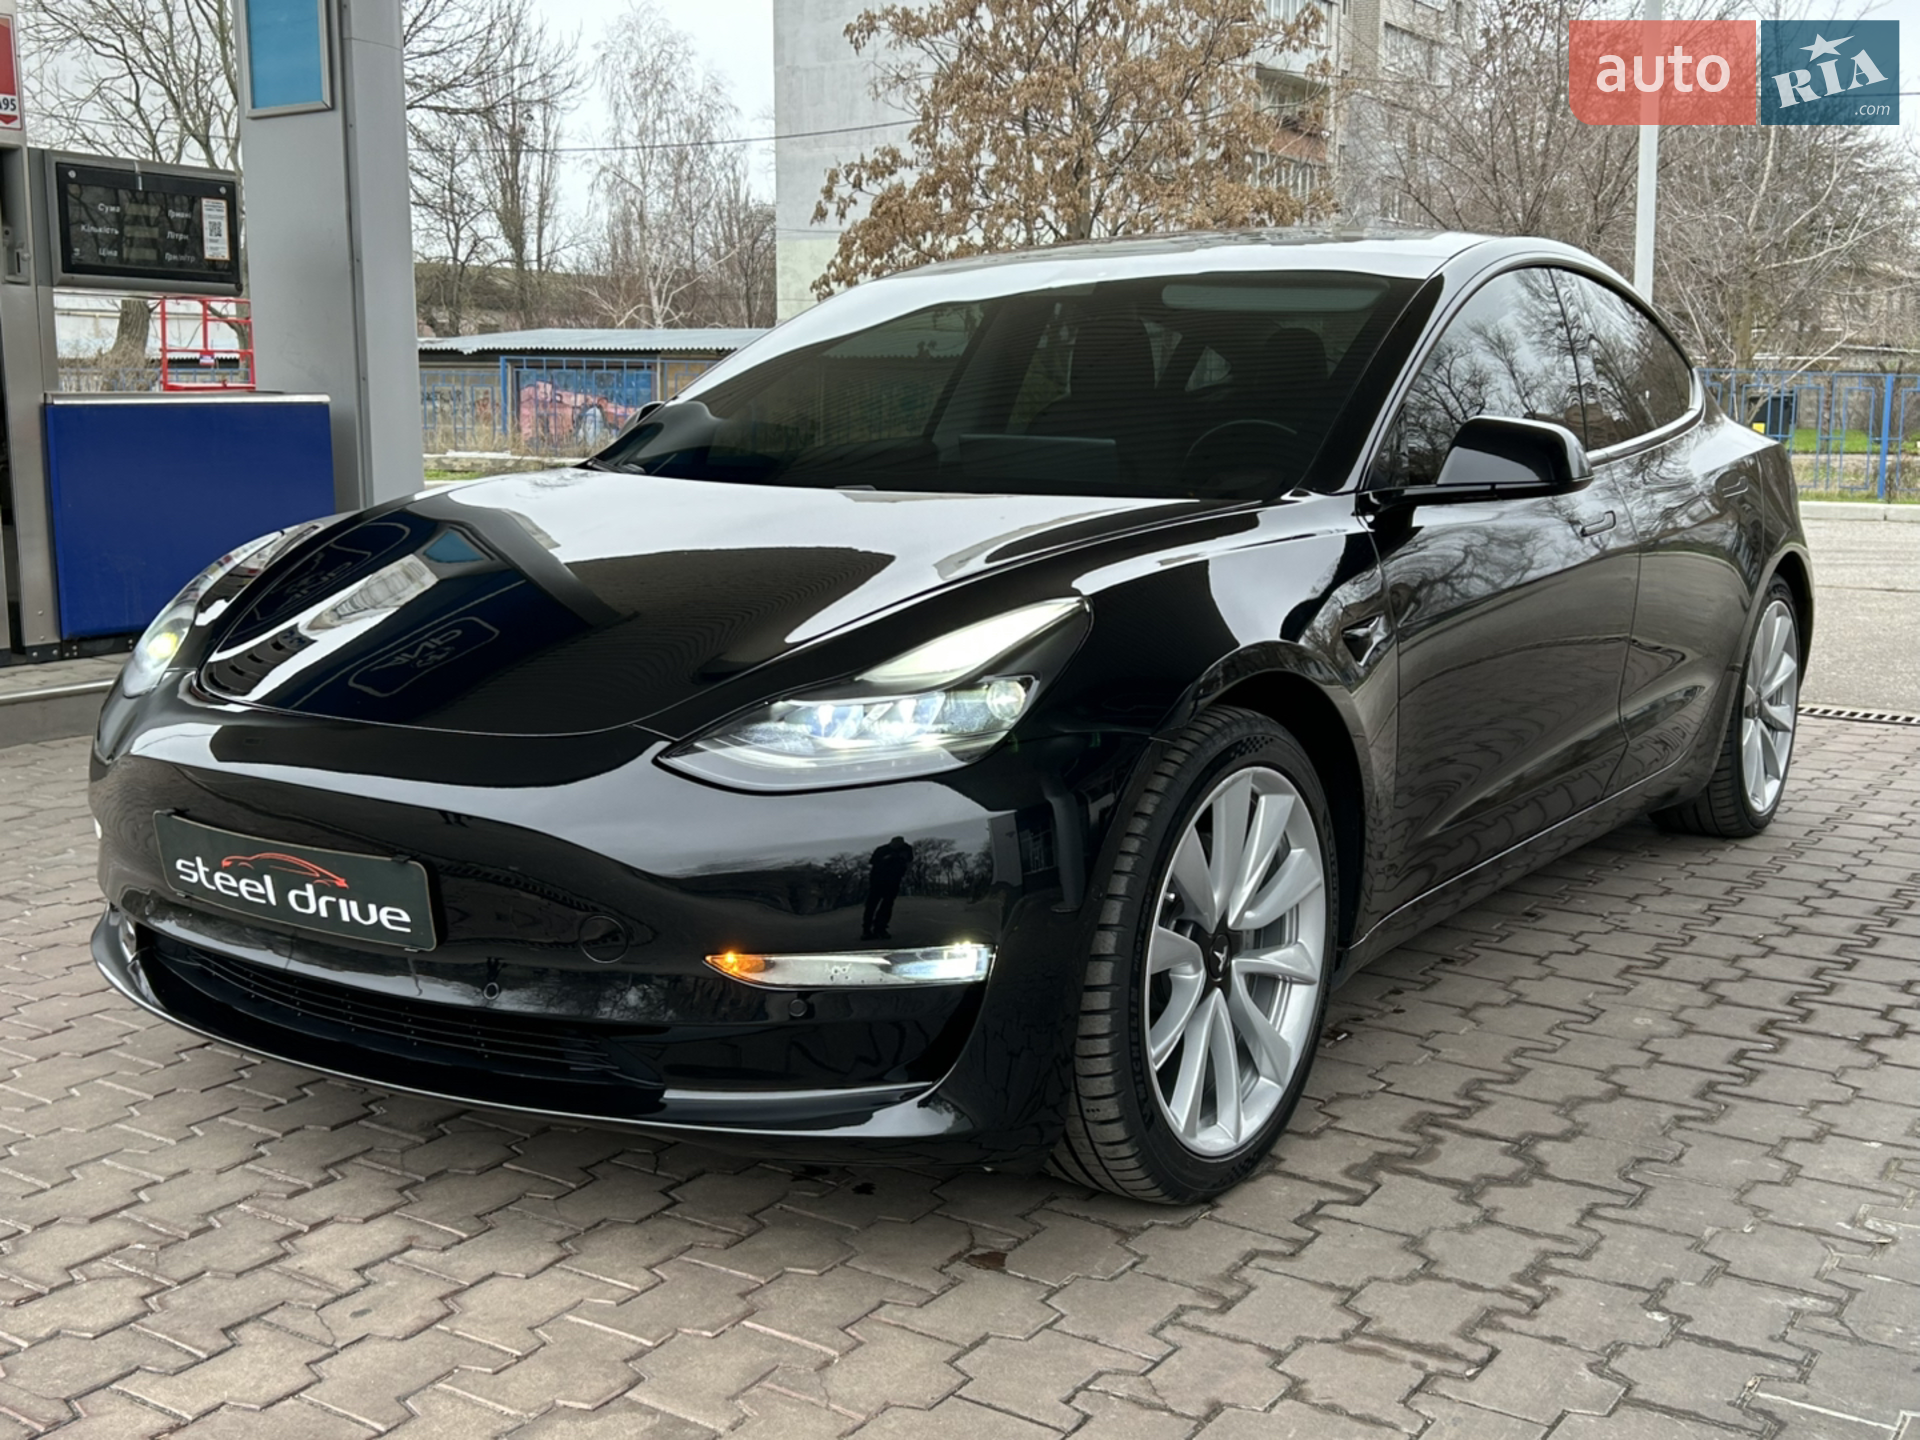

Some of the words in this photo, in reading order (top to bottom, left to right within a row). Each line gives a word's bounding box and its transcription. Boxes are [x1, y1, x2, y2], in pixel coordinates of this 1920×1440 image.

[97, 202, 121, 214] Сума
[80, 224, 119, 235] Кількість
[166, 230, 189, 242] Літри
[98, 247, 118, 257] Ціна
[175, 856, 277, 907] steel
[287, 883, 412, 933] drive
[1128, 986, 1149, 1099] MICHELIN
